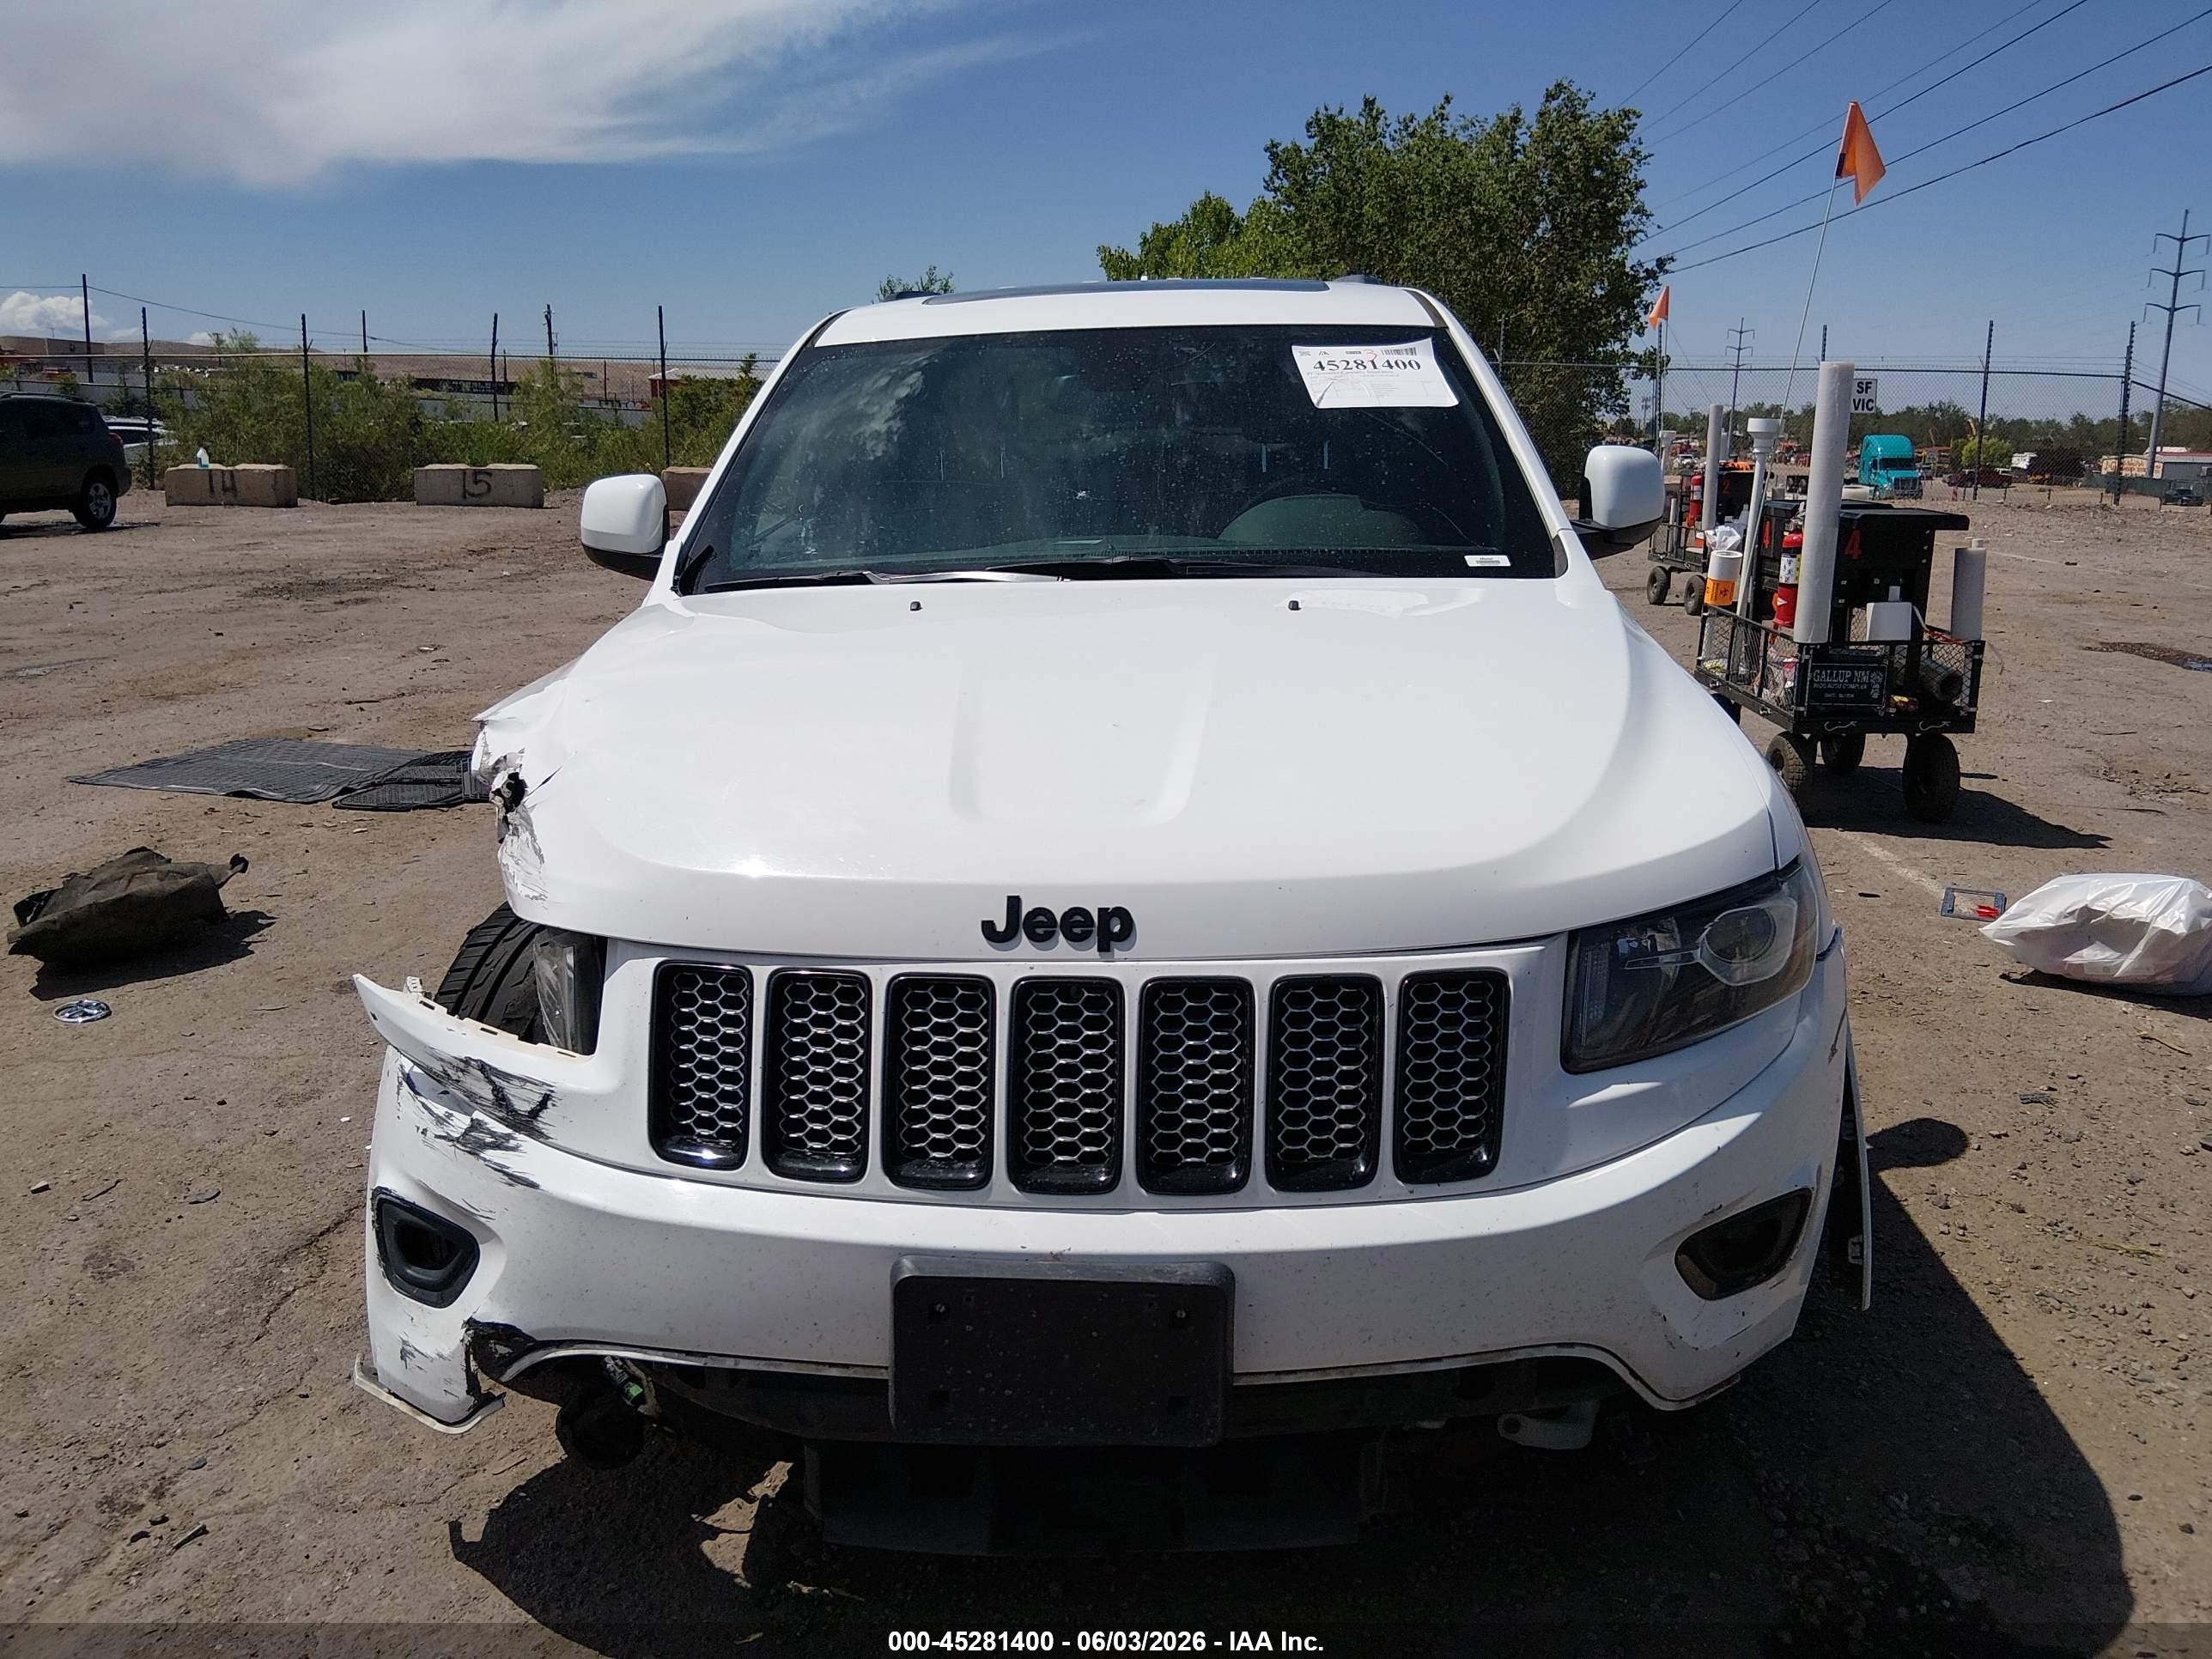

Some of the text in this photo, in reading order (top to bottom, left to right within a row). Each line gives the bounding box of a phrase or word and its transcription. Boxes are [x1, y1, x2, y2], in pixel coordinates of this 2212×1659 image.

[1313, 359, 1421, 372] 45281400
[1856, 381, 1872, 394] SF
[1852, 398, 1875, 411] VIC
[209, 470, 238, 497] 14
[463, 470, 492, 499] 15
[1723, 478, 1731, 495] 2
[1844, 528, 1862, 559] 4
[1813, 670, 1870, 683] GALLUP NM
[981, 895, 1134, 953] Jeep
